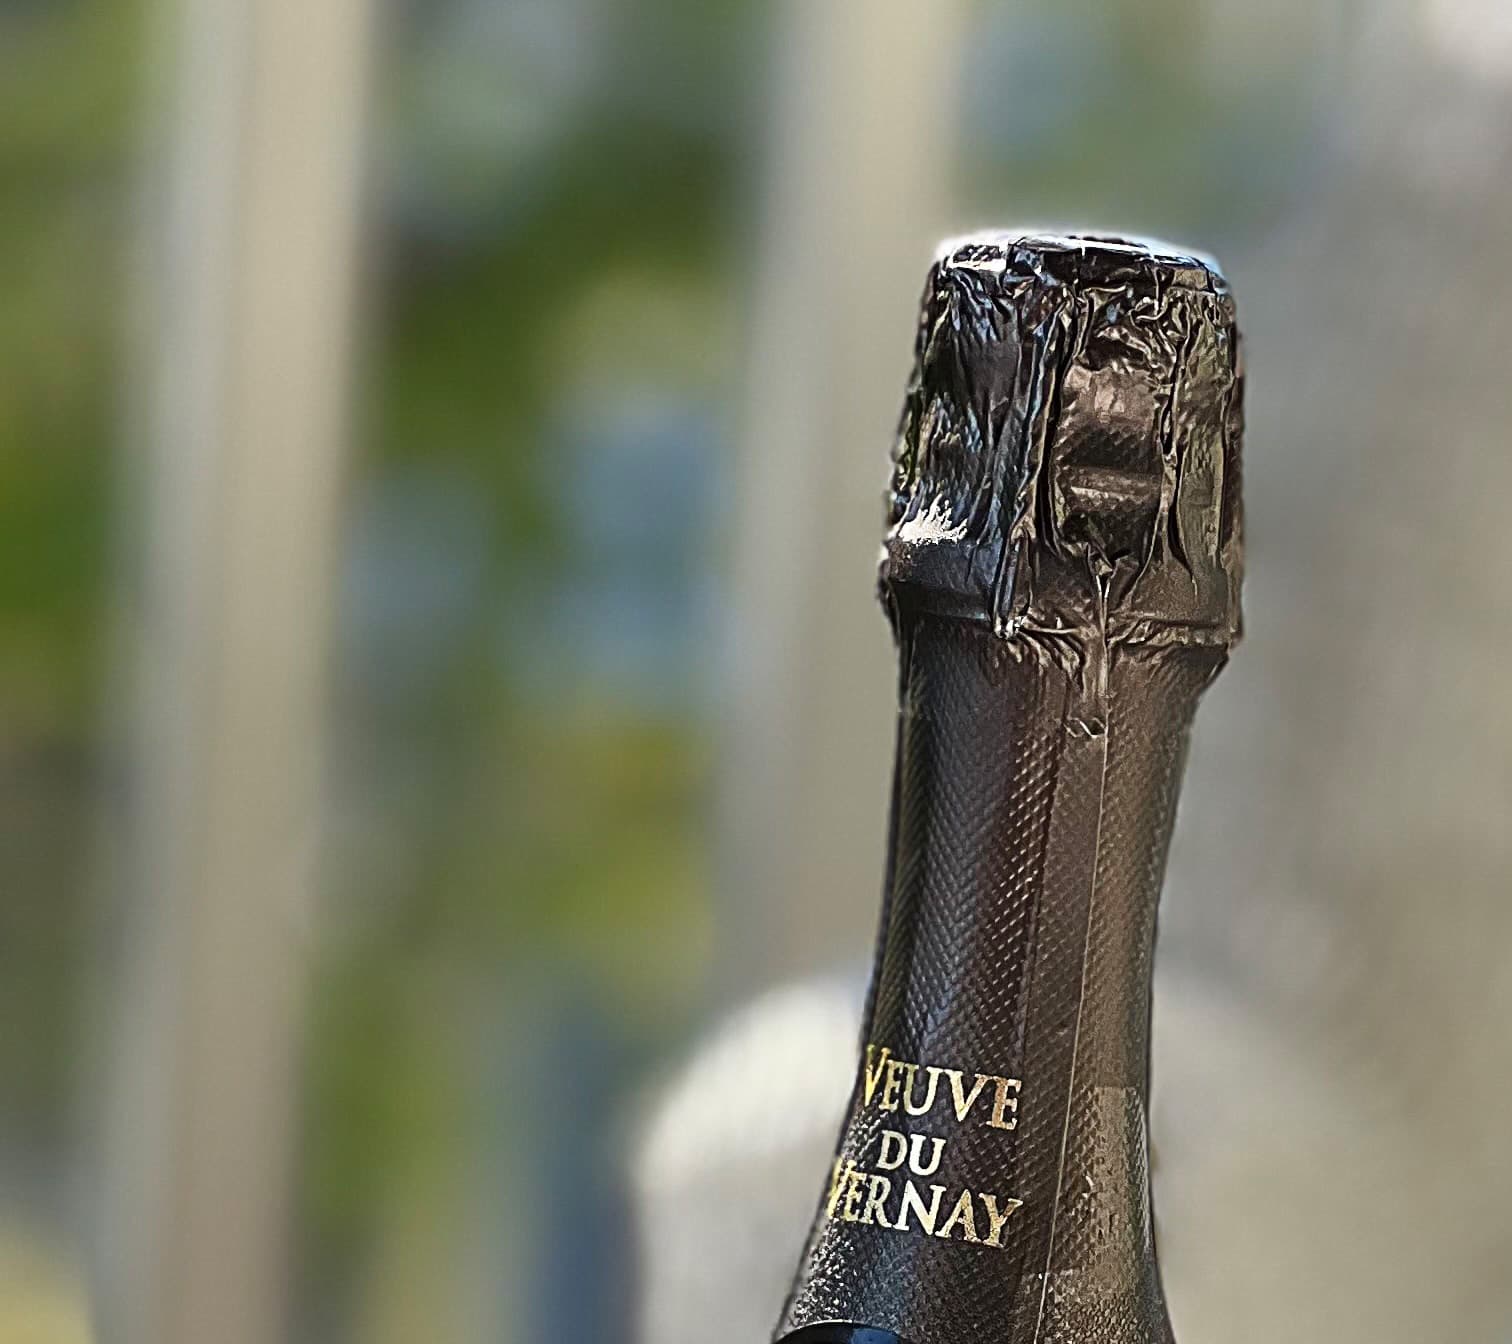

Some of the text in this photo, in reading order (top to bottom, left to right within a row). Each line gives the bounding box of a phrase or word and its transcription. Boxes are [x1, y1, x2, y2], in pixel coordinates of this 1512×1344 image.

[864, 1045, 1022, 1130] VEUVE
[876, 1129, 946, 1176] DU
[826, 1157, 1024, 1249] VERNAY
